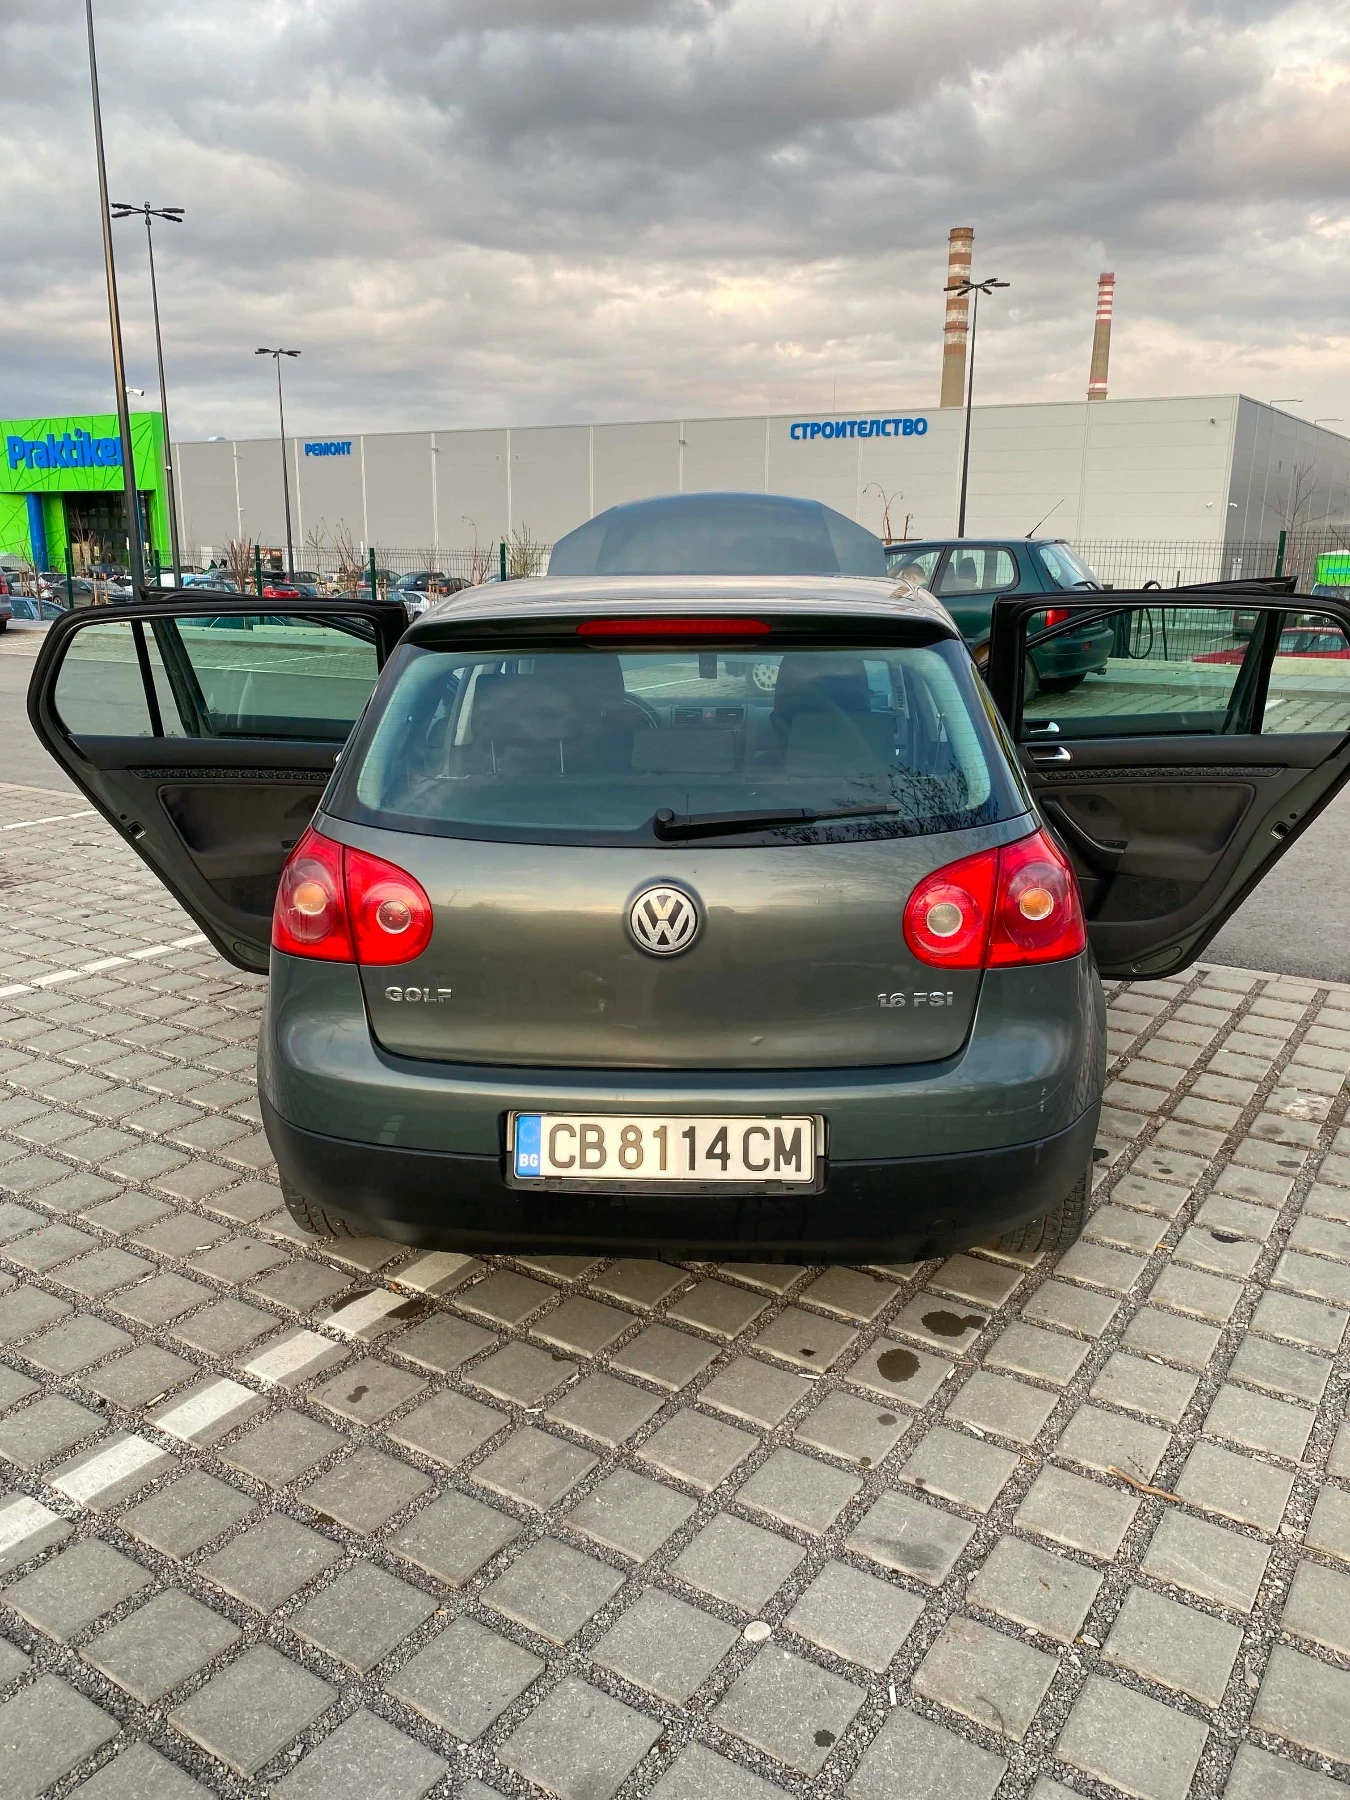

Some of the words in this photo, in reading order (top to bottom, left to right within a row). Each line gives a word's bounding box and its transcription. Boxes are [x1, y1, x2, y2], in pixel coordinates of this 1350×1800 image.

[790, 417, 928, 440] СТРОИТЕЛСТВО
[304, 441, 352, 457] РЕМОНТ
[384, 986, 452, 1003] GOLF
[913, 991, 954, 1007] FSI
[519, 1153, 538, 1167] BG
